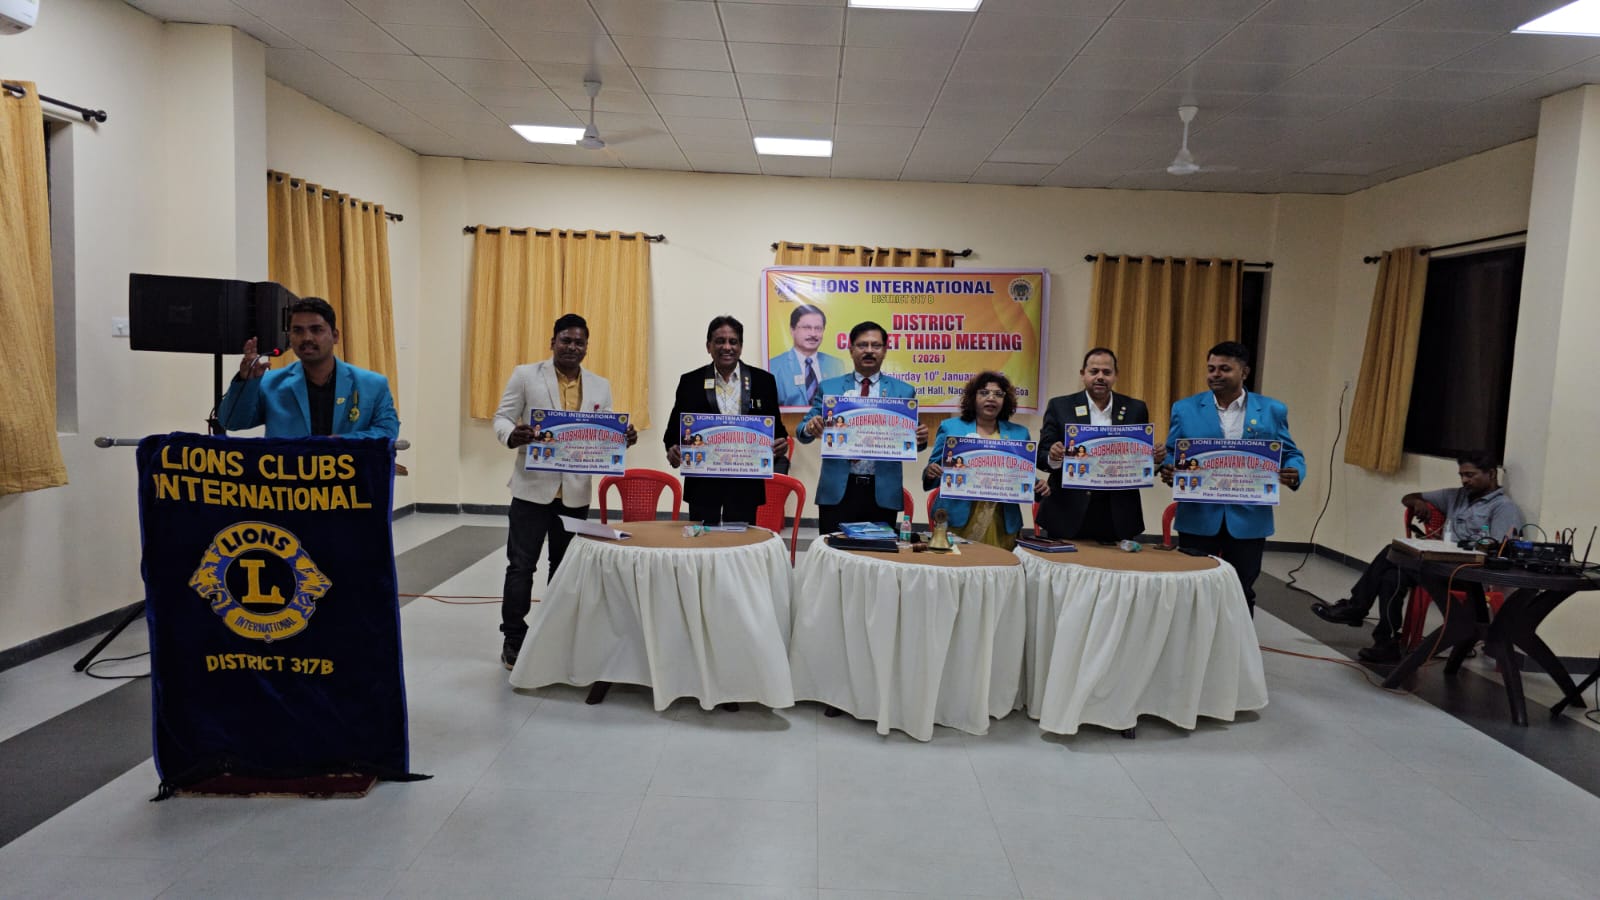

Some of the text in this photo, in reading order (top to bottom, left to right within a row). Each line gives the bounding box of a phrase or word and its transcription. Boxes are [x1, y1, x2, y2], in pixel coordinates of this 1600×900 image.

[811, 279, 994, 294] LIONS INTERNATIONAL
[871, 294, 909, 304] DISTRICT
[892, 314, 964, 332] DISTRICT
[905, 333, 950, 350] THIRD
[955, 333, 1022, 351] MEETING
[162, 445, 356, 481] LIONS CLUBS
[152, 473, 372, 511] INTERNATIONAL
[220, 528, 291, 553] LIONS
[239, 559, 286, 604] L
[234, 615, 298, 634] INTERNATIONAL
[205, 653, 334, 675] DISTRICT 317B
